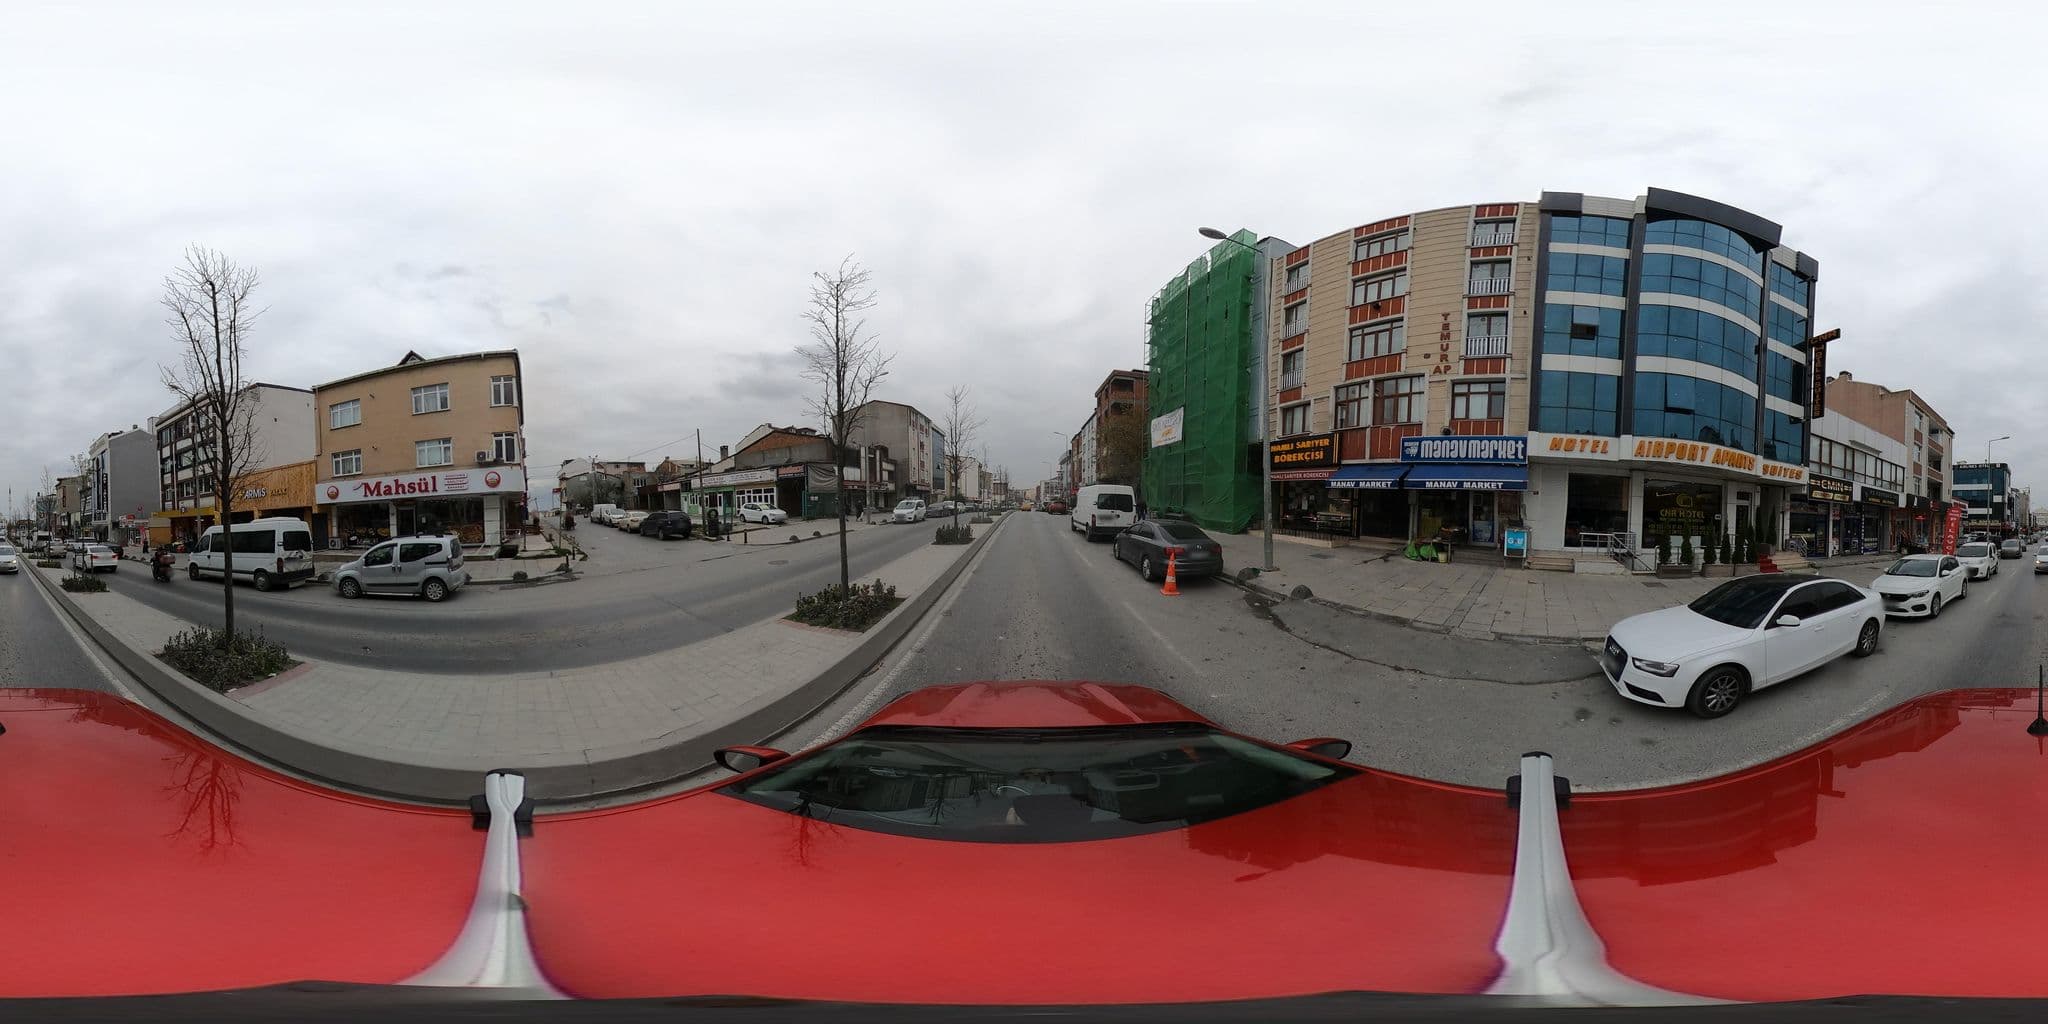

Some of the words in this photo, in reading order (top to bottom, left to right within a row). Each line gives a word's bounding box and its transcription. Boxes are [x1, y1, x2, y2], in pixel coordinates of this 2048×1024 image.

[1440, 312, 1450, 362] TEMUR
[1433, 364, 1451, 375] AP
[1296, 438, 1330, 449] SARIYER
[1549, 437, 1609, 453] HOTEL
[363, 475, 438, 498] Mahsül
[1425, 481, 1458, 489] MANAV
[1463, 481, 1504, 489] MARKET
